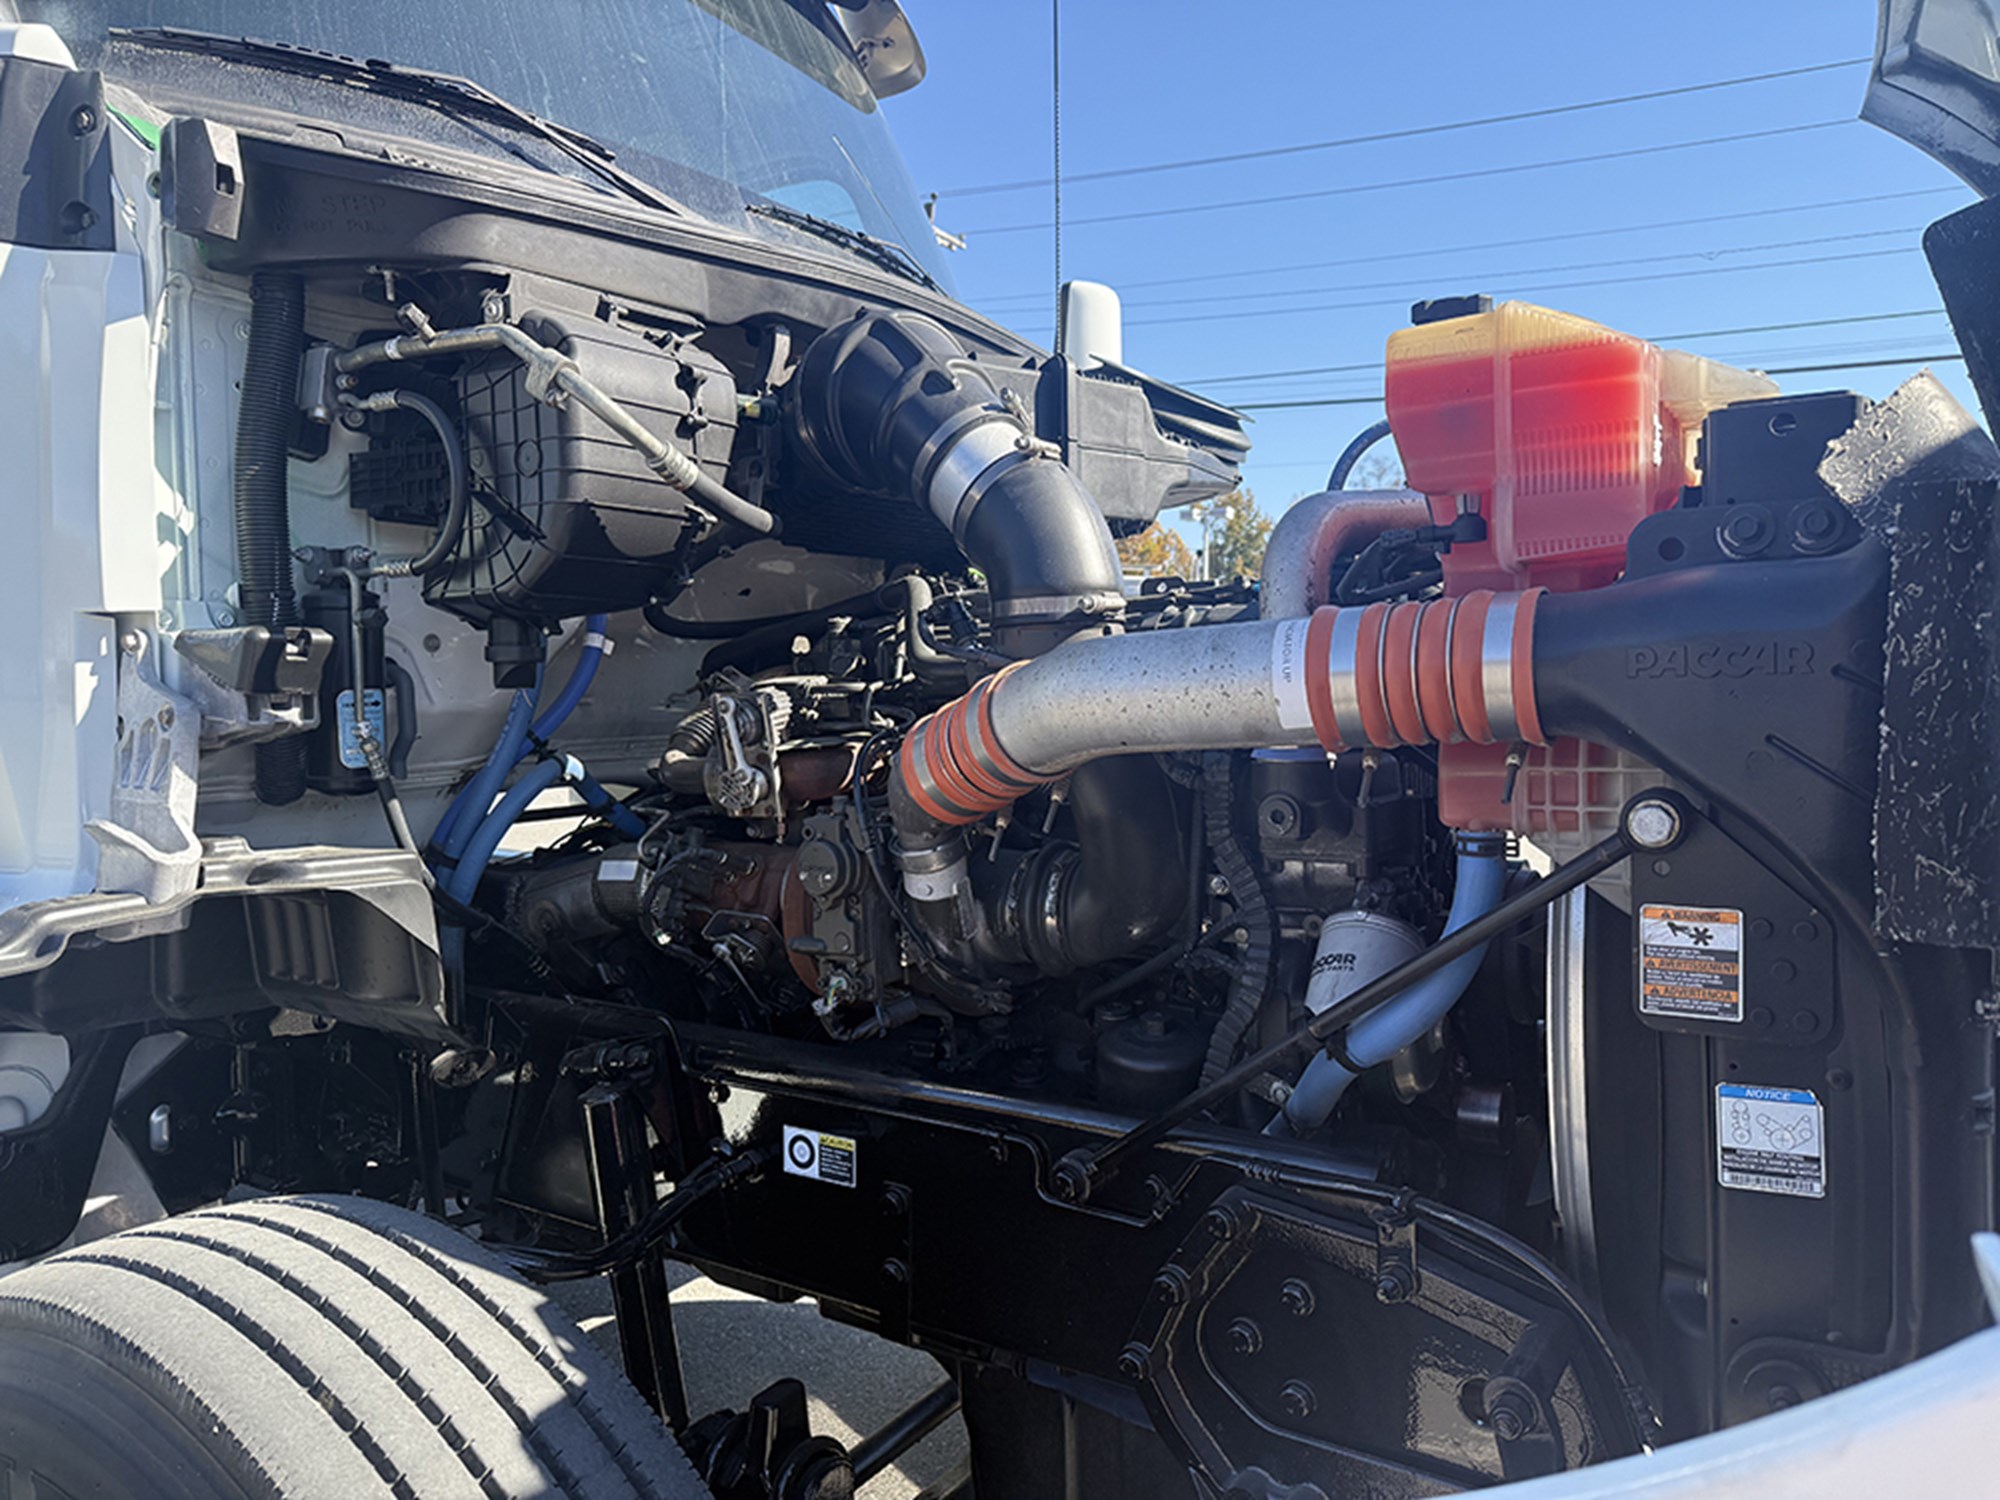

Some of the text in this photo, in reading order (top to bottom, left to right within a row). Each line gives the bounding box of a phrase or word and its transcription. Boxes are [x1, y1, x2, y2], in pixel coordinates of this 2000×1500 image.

[321, 193, 387, 214] STEP
[1626, 641, 1815, 679] PACCAR
[1673, 911, 1722, 922] WARNING
[1745, 1089, 1792, 1101] NOTICE
